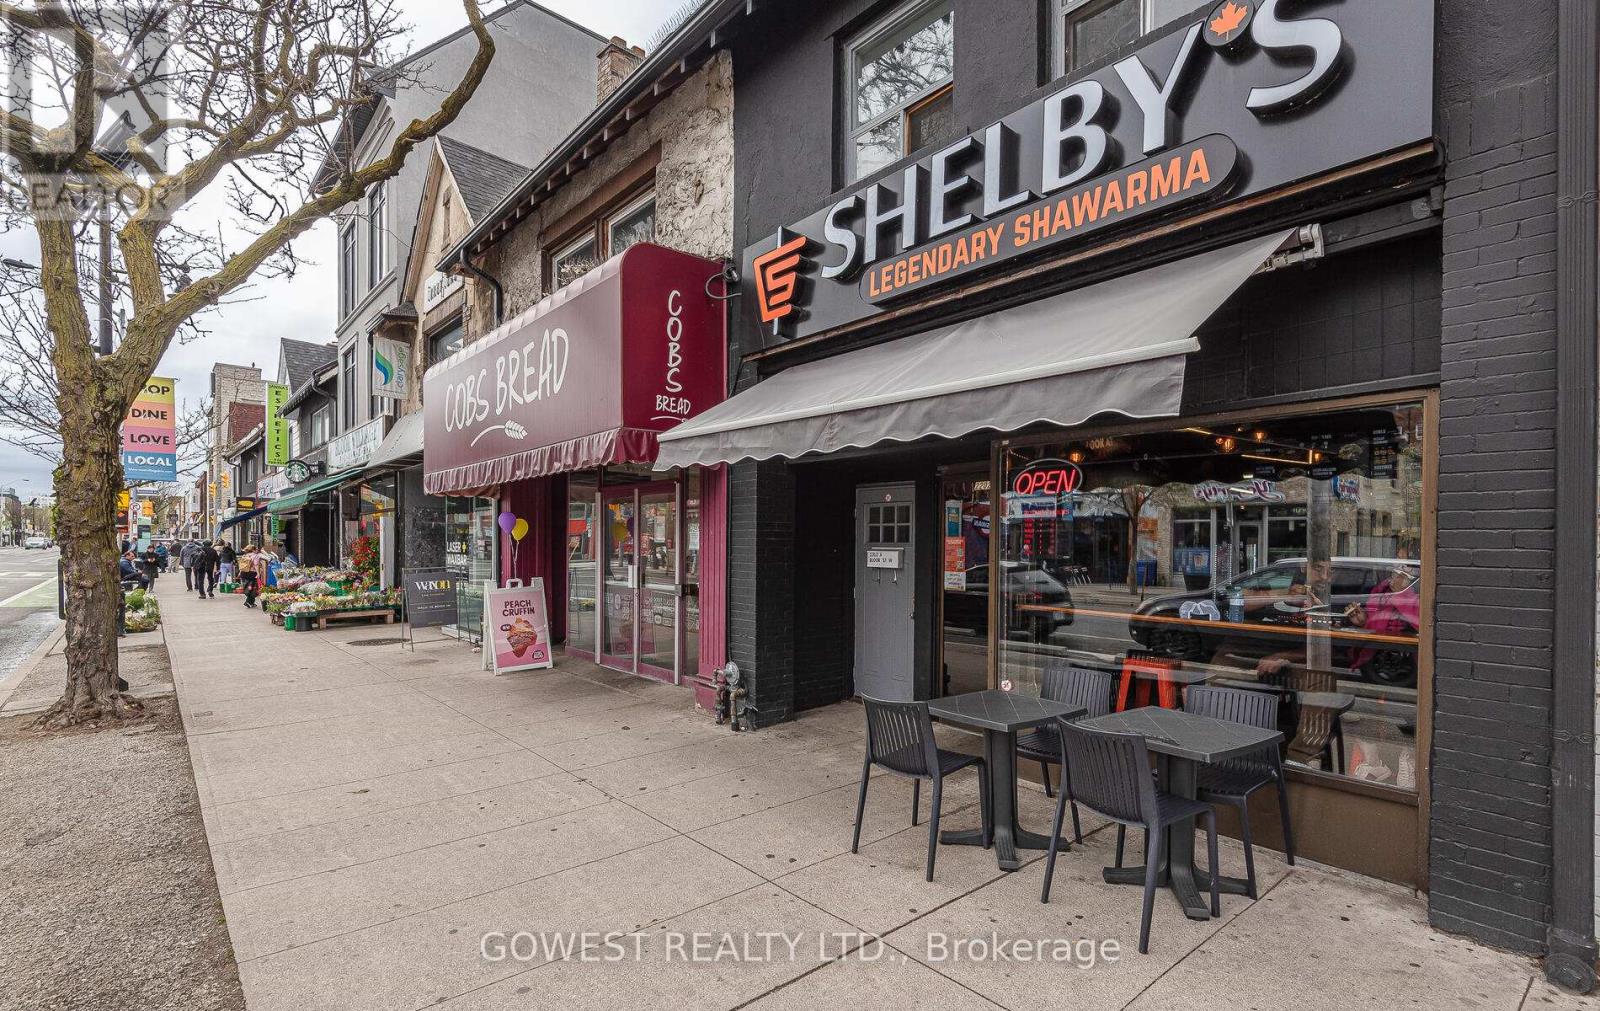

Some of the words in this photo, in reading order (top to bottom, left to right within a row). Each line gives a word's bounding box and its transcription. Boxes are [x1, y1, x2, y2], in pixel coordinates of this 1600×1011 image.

[868, 222, 1003, 298] LEGENDARY
[1013, 148, 1211, 247] SHAWARMA
[665, 289, 683, 393] COBS
[445, 368, 490, 433] COBS
[495, 328, 569, 416] BREAD
[144, 384, 170, 396] OP
[655, 394, 691, 415] BREAD
[131, 408, 168, 420] DINE
[130, 433, 170, 445] LOVE
[128, 455, 173, 467] LOCAL
[1016, 469, 1076, 495] OPEN
[504, 600, 531, 608] PEACH
[502, 607, 535, 617] CRUFFIN
